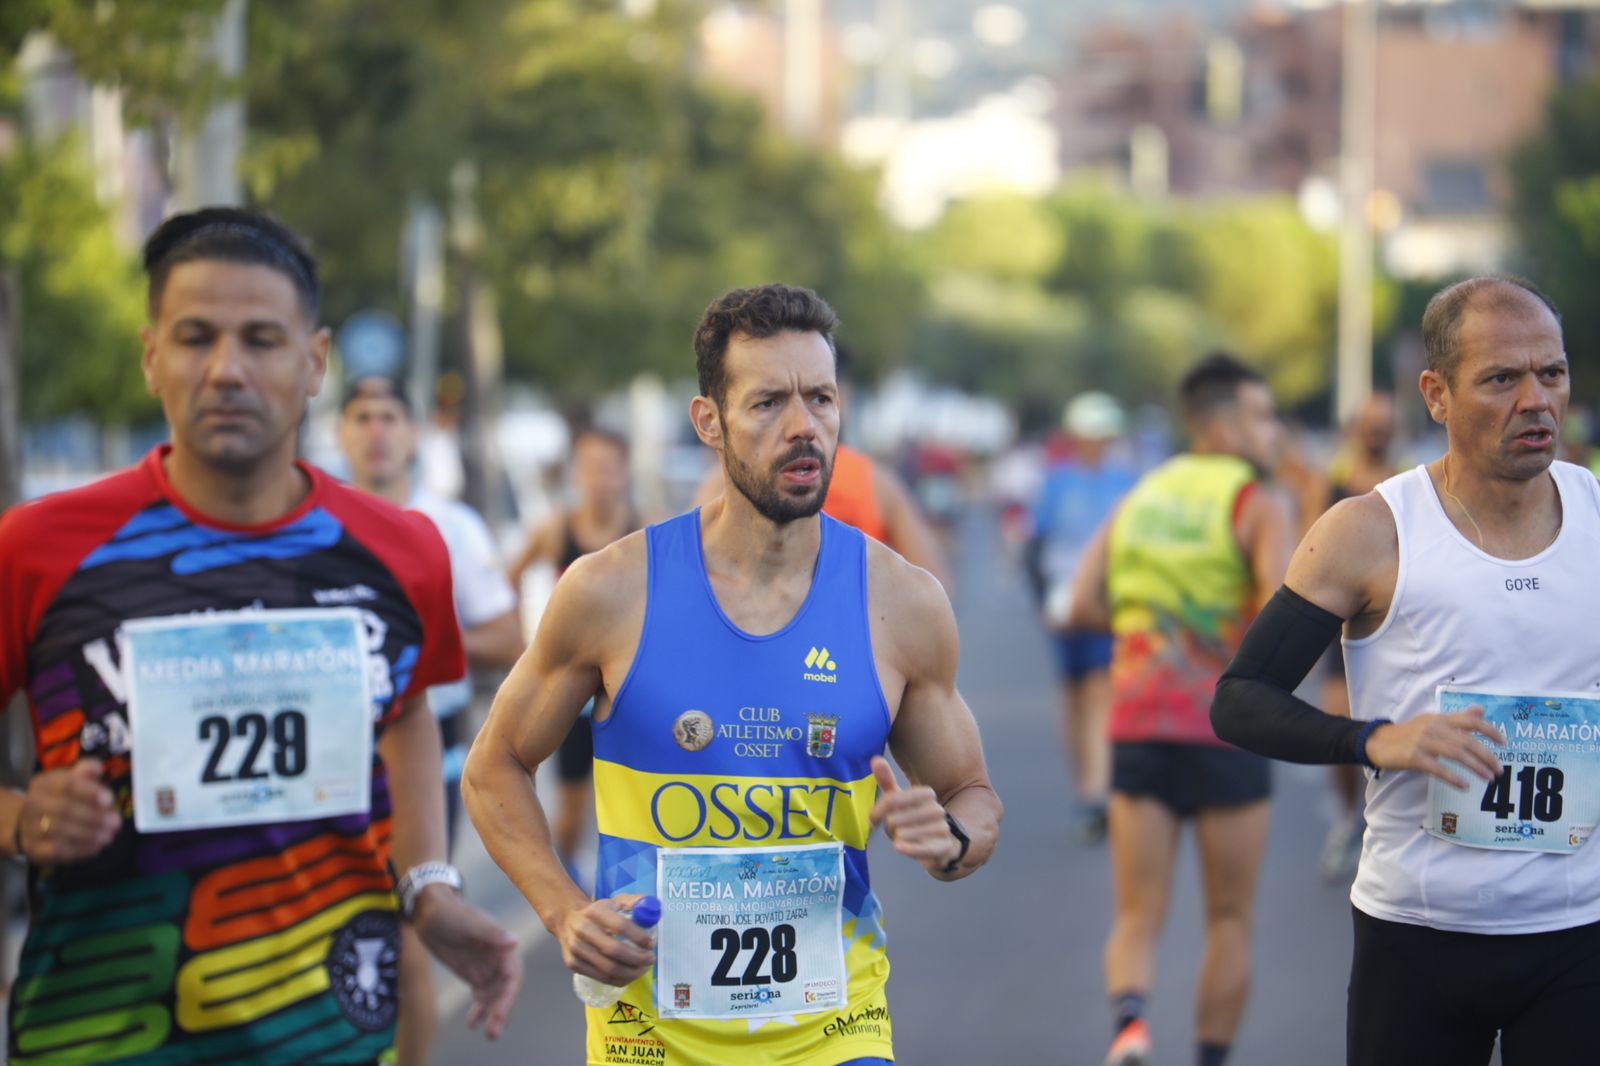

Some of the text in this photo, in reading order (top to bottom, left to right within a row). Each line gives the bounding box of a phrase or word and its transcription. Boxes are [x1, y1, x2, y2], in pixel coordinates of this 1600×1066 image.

[1505, 577, 1540, 591] GORE
[139, 656, 224, 680] MEDIA
[804, 672, 837, 683] mobel
[739, 707, 781, 722] CLUB
[716, 724, 803, 741] ATLETISMO
[199, 710, 307, 784] 229
[735, 742, 783, 758] OSSET
[1568, 743, 1585, 752] DEL
[1480, 765, 1564, 822] 418
[651, 781, 852, 841] OSSET
[668, 872, 838, 899] MEDIA MARATÓN
[796, 895, 815, 905] DEL
[695, 913, 731, 925] ANTONIO
[786, 908, 809, 921] ZAFRA
[710, 923, 798, 986] 228
[631, 1046, 665, 1058] JUAN
